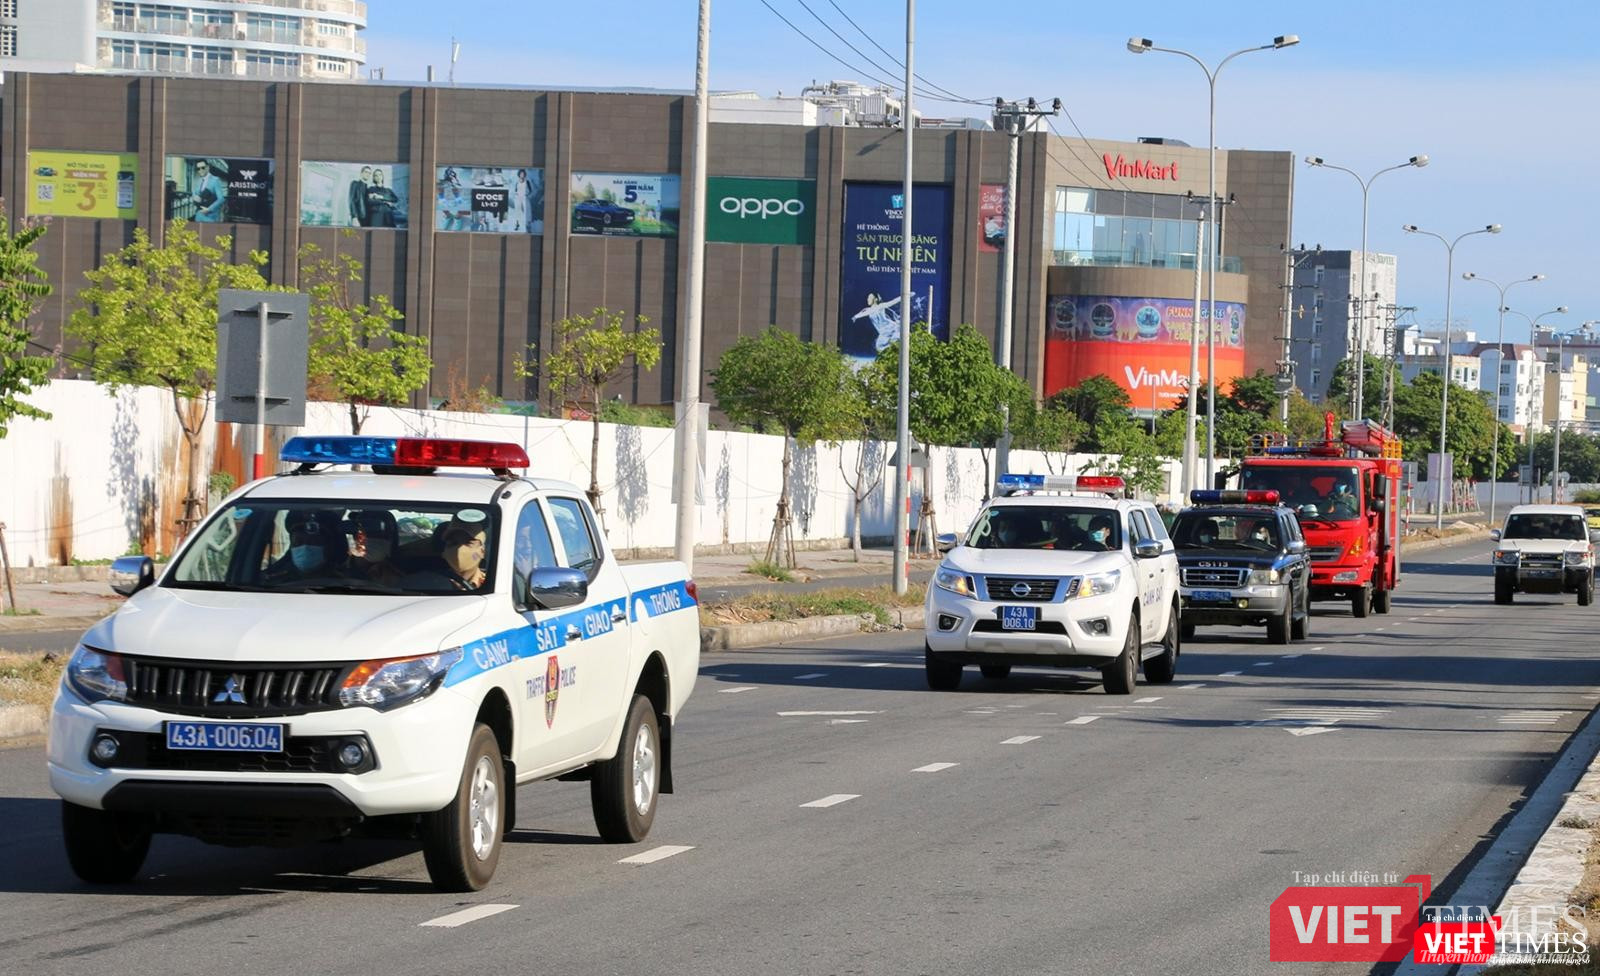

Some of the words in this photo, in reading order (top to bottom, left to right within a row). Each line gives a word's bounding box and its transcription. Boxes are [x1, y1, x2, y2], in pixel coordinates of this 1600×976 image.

[1103, 152, 1180, 181] VinMart
[77, 182, 96, 211] 3
[624, 185, 637, 203] 5
[720, 197, 804, 219] oppo
[878, 234, 903, 244] TRƯỢ
[856, 245, 880, 264] TỰ
[1168, 307, 1193, 317] FUNN
[1010, 607, 1028, 618] 43A
[472, 638, 510, 670] CẢNH
[536, 620, 558, 652] SÁT
[585, 612, 611, 636] GIAO
[650, 587, 681, 616] THÔNG
[1004, 617, 1034, 629] 006.10
[527, 675, 545, 700] TRAFFIC
[561, 666, 576, 688] POLICE
[172, 725, 278, 749] 43A-006.04
